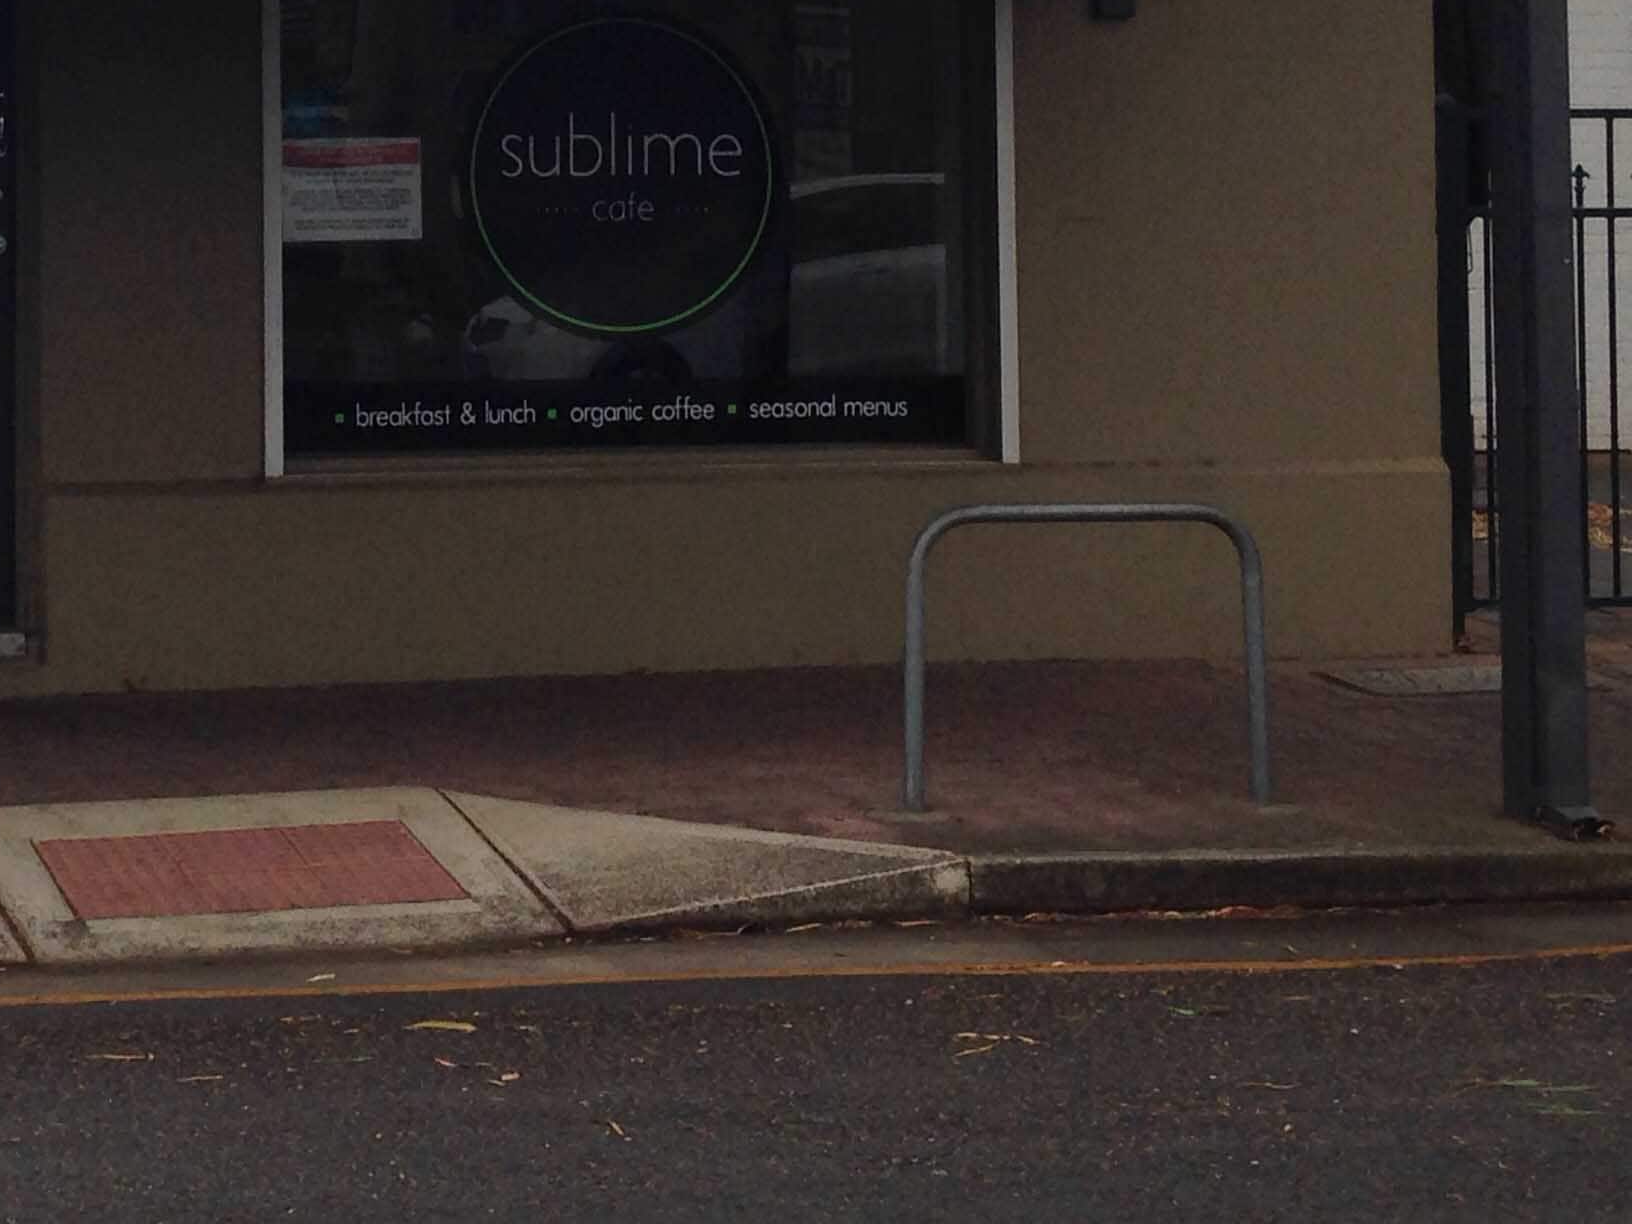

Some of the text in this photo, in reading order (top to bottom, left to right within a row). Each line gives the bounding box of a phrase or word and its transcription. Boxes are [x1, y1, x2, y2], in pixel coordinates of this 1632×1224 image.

[501, 112, 743, 177] sublime
[591, 191, 656, 222] cafe
[355, 392, 908, 428] breakfast & lunch organic coffee seasonal menus
